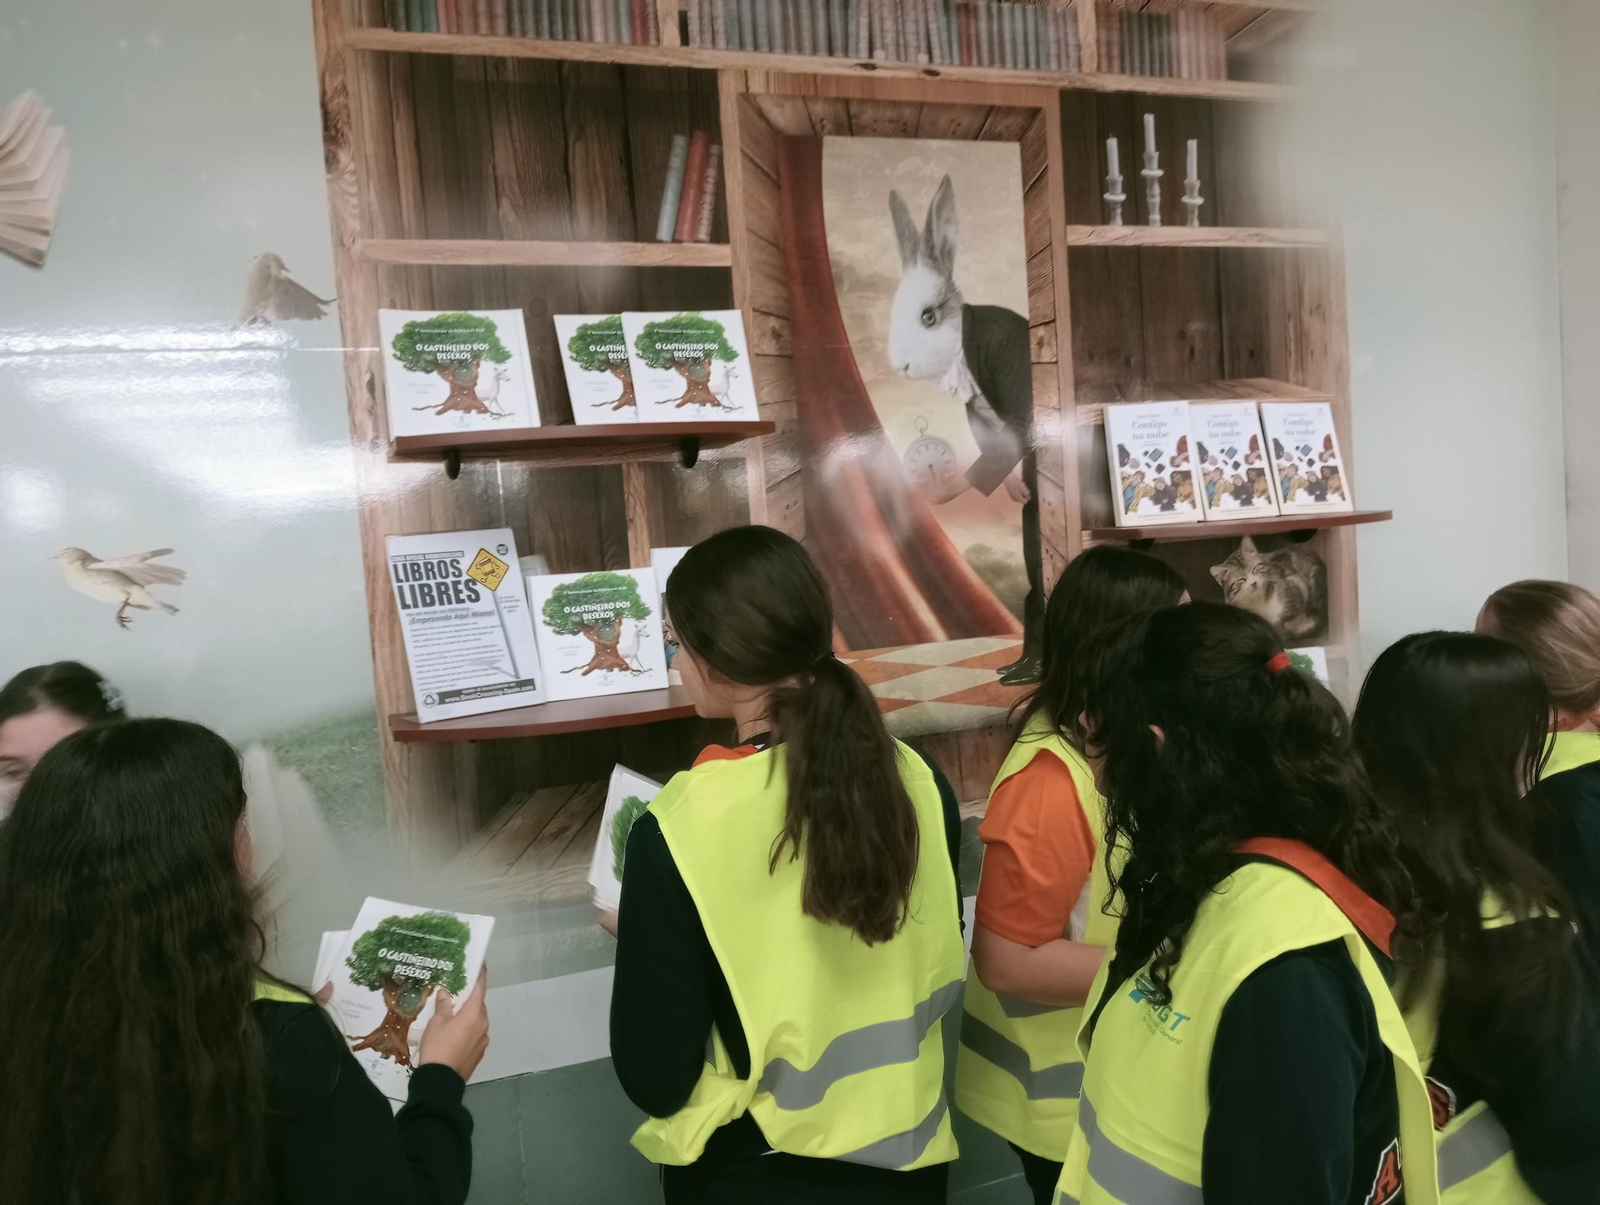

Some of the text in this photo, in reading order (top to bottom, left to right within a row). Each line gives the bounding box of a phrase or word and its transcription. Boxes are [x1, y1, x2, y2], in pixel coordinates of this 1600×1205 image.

[472, 342, 489, 351] DOS
[589, 343, 626, 352] O CASTIÑE
[704, 342, 720, 350] DOS
[437, 352, 472, 360] DESEXOS
[673, 350, 704, 359] DESEXOS
[1132, 429, 1169, 440] na nube
[1208, 428, 1242, 439] na nube
[1284, 426, 1316, 436] na nube
[393, 559, 463, 583] LIBROS
[397, 579, 481, 610] LIBRES
[571, 602, 616, 613] CASTIÑEIRO
[616, 601, 631, 609] DOS
[582, 611, 615, 620] DESEXOS
[378, 948, 388, 957] O
[437, 960, 454, 971] DOS
[393, 964, 432, 980] DESEXOS
